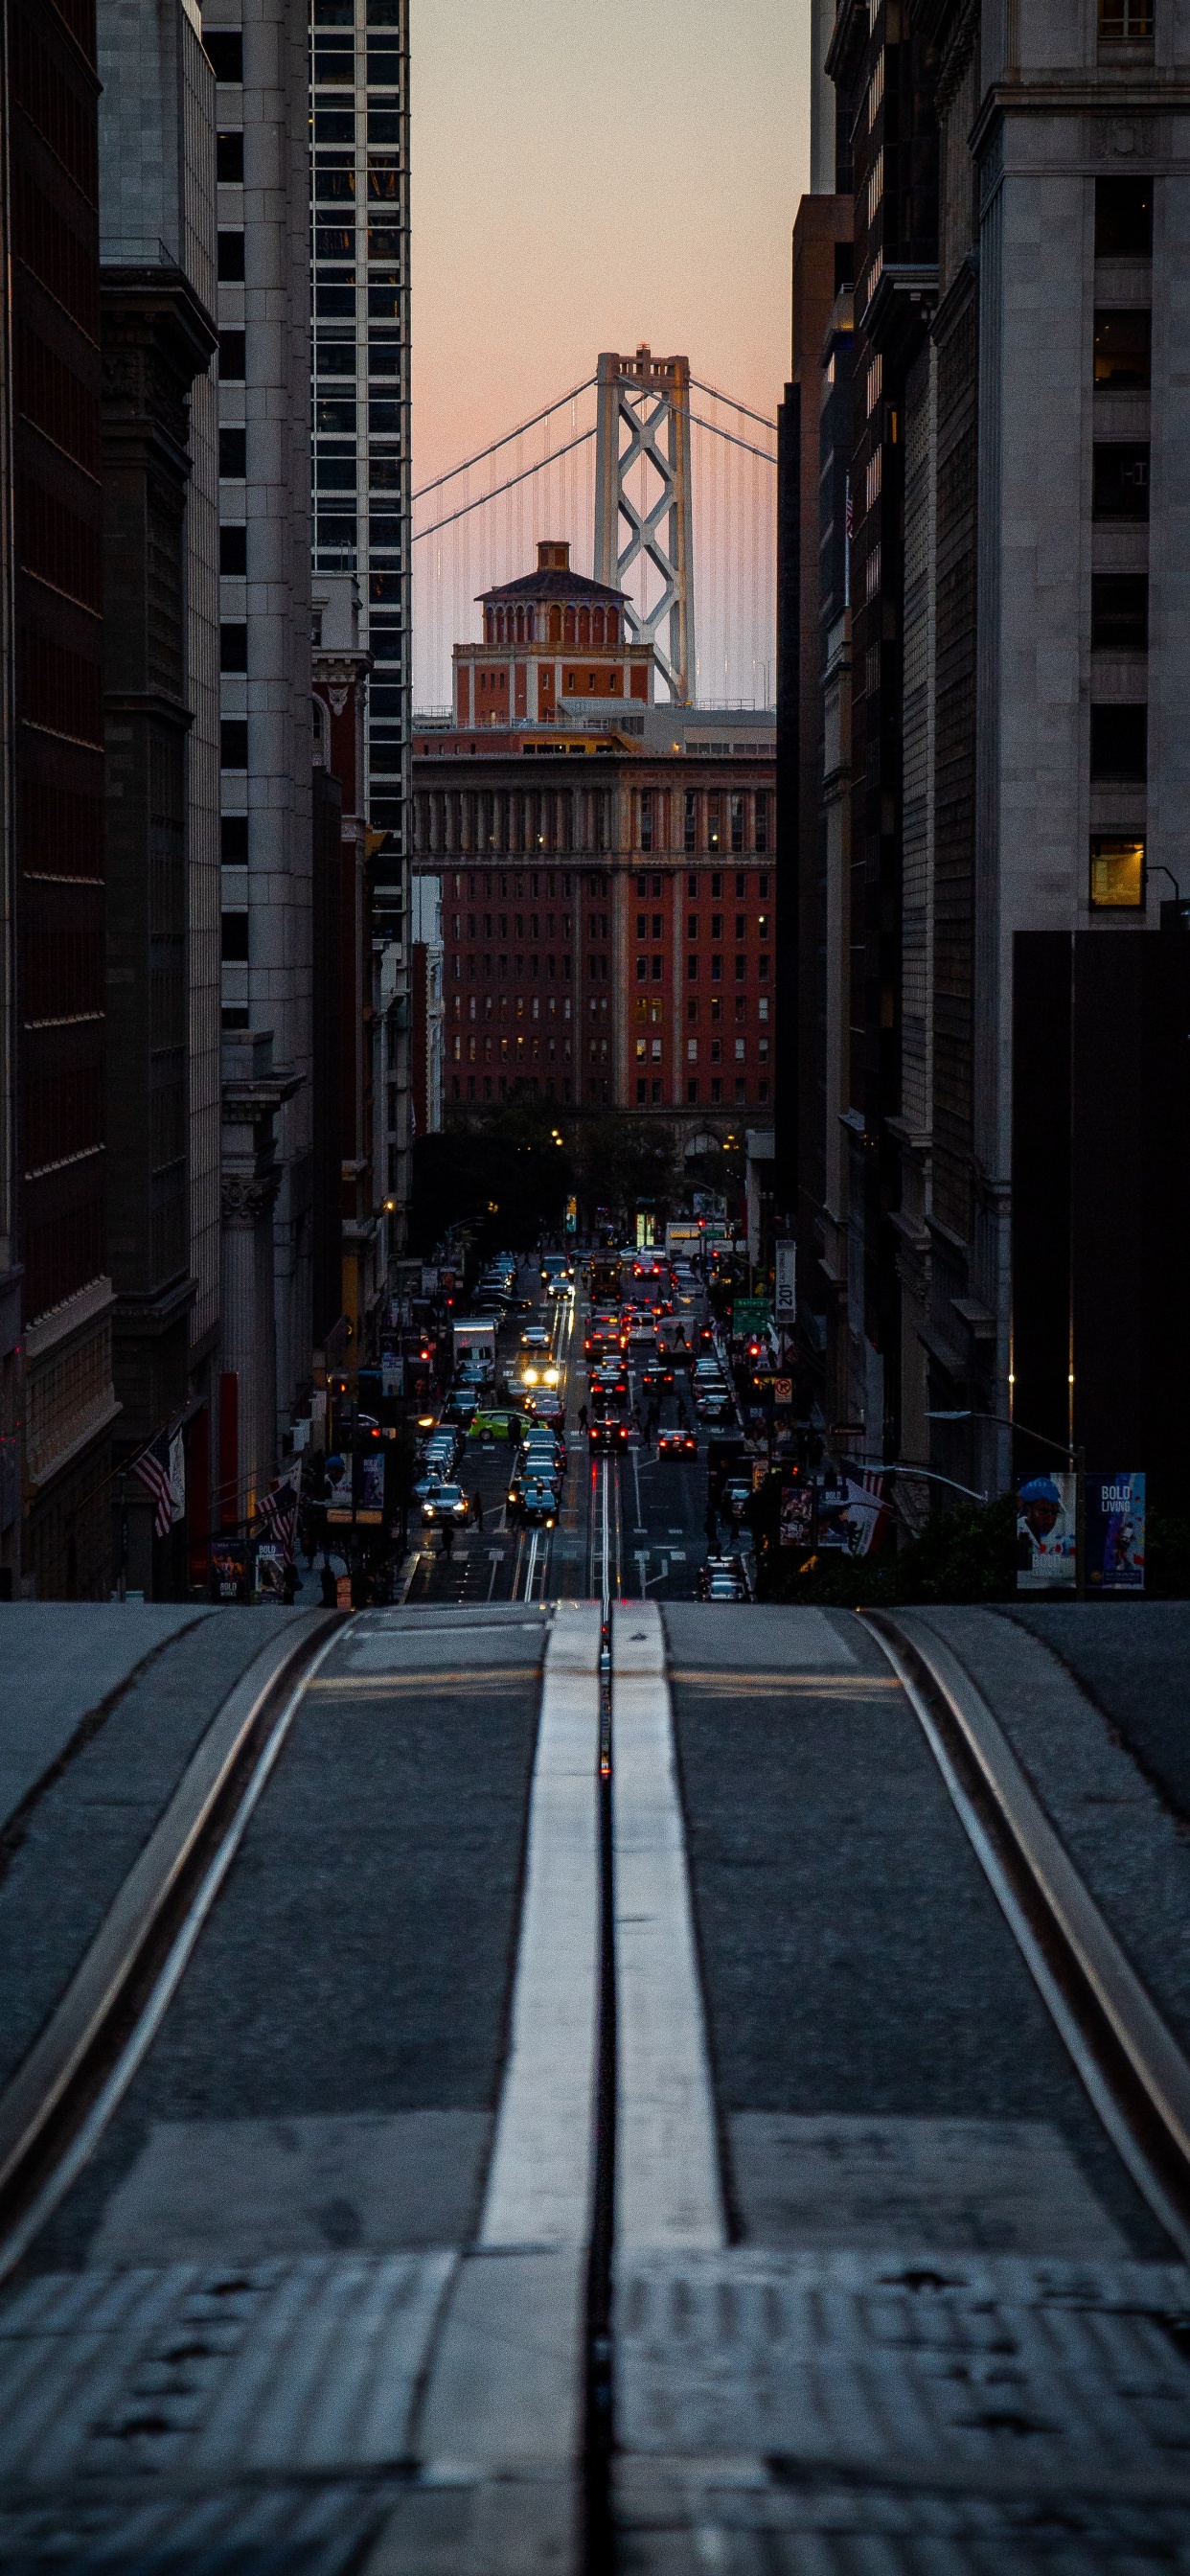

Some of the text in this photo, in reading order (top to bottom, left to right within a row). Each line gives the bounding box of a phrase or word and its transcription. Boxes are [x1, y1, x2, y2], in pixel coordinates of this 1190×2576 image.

[779, 1284, 792, 1306] 201
[1101, 1485, 1131, 1500] BOLD
[1101, 1501, 1131, 1512] LIVING
[259, 1545, 276, 1553] BOLD
[219, 1582, 237, 1591] BOLD
